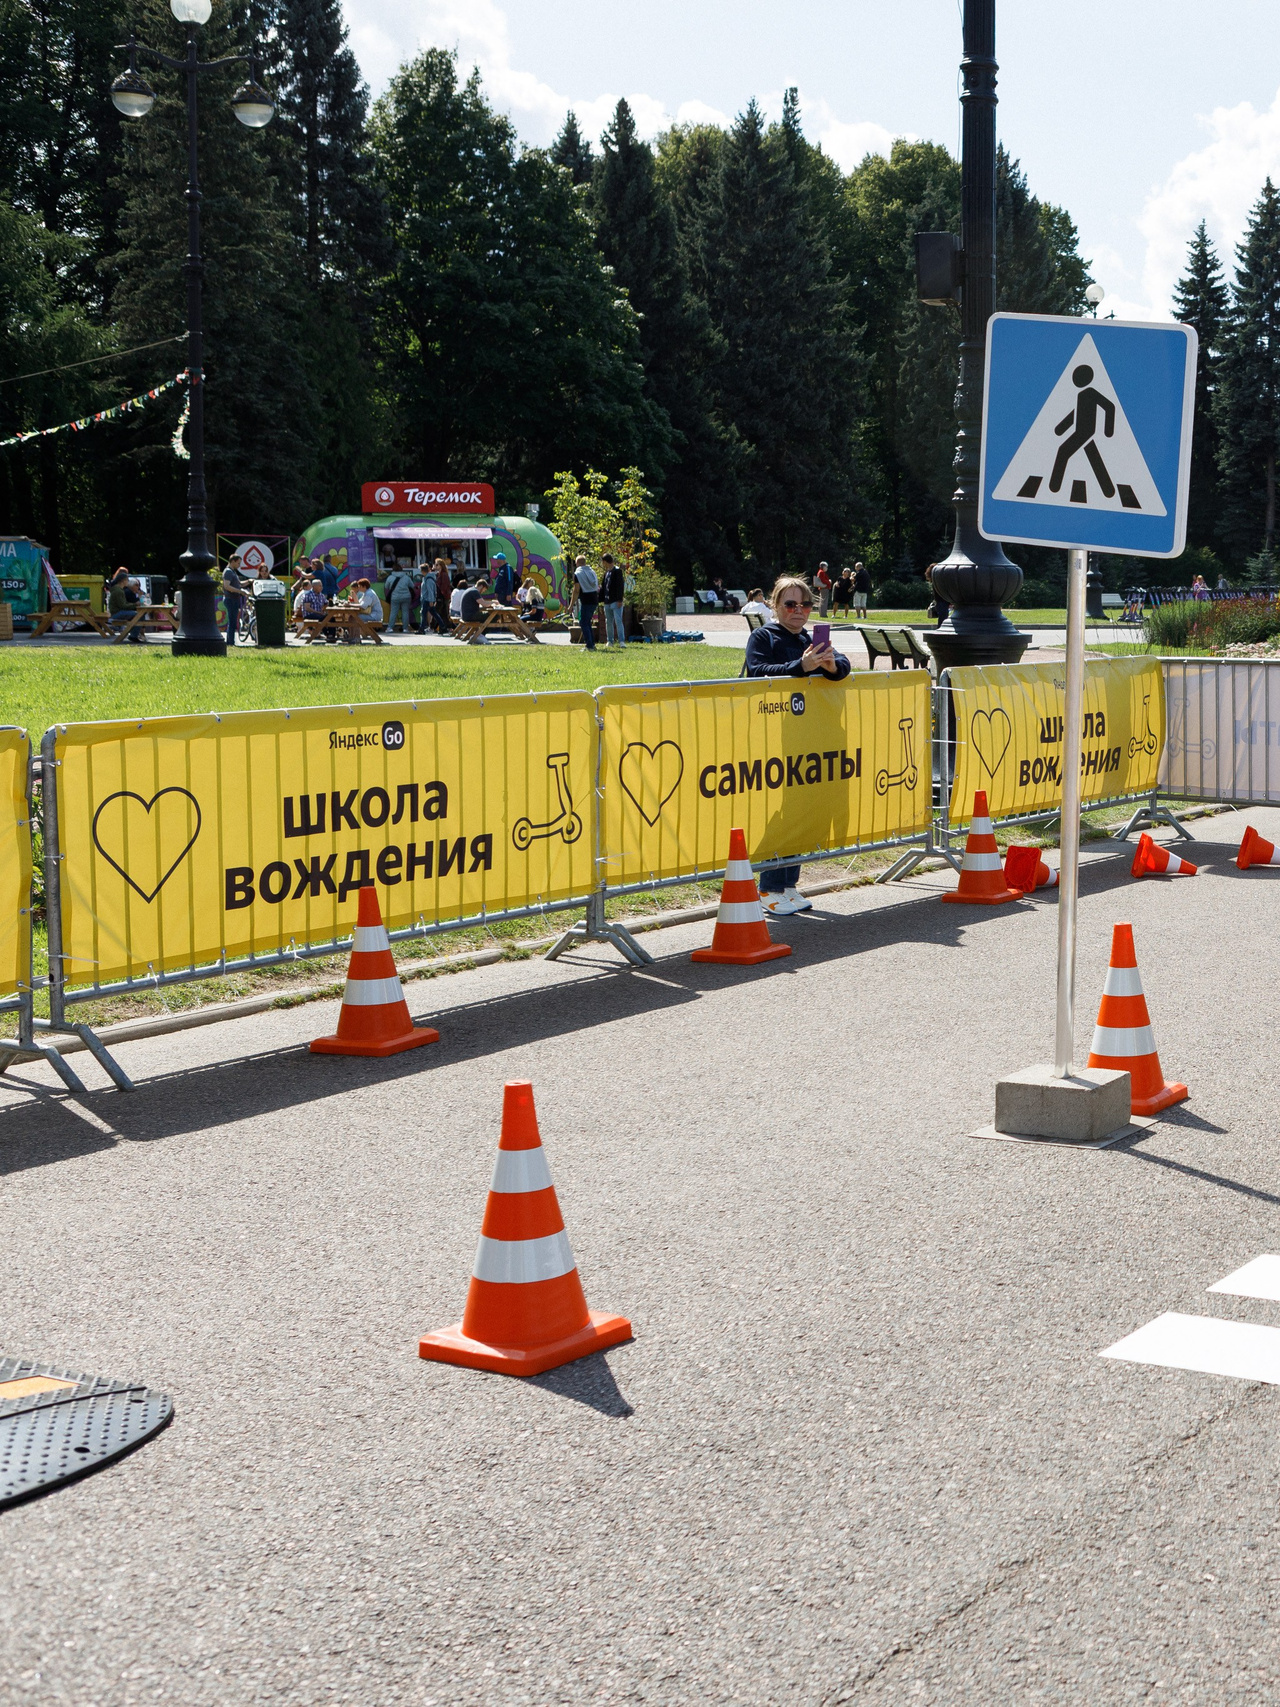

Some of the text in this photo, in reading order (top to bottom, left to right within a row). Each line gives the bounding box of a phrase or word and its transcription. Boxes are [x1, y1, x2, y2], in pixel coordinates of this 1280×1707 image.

[404, 488, 482, 506] Теремок
[757, 697, 805, 715] Яндекс Go
[329, 727, 403, 751] Яндекс Go
[1040, 711, 1106, 743] шла
[699, 748, 862, 799] самокаты
[1019, 746, 1122, 787] вожния
[283, 780, 448, 839] школа
[225, 833, 493, 911] вождения
